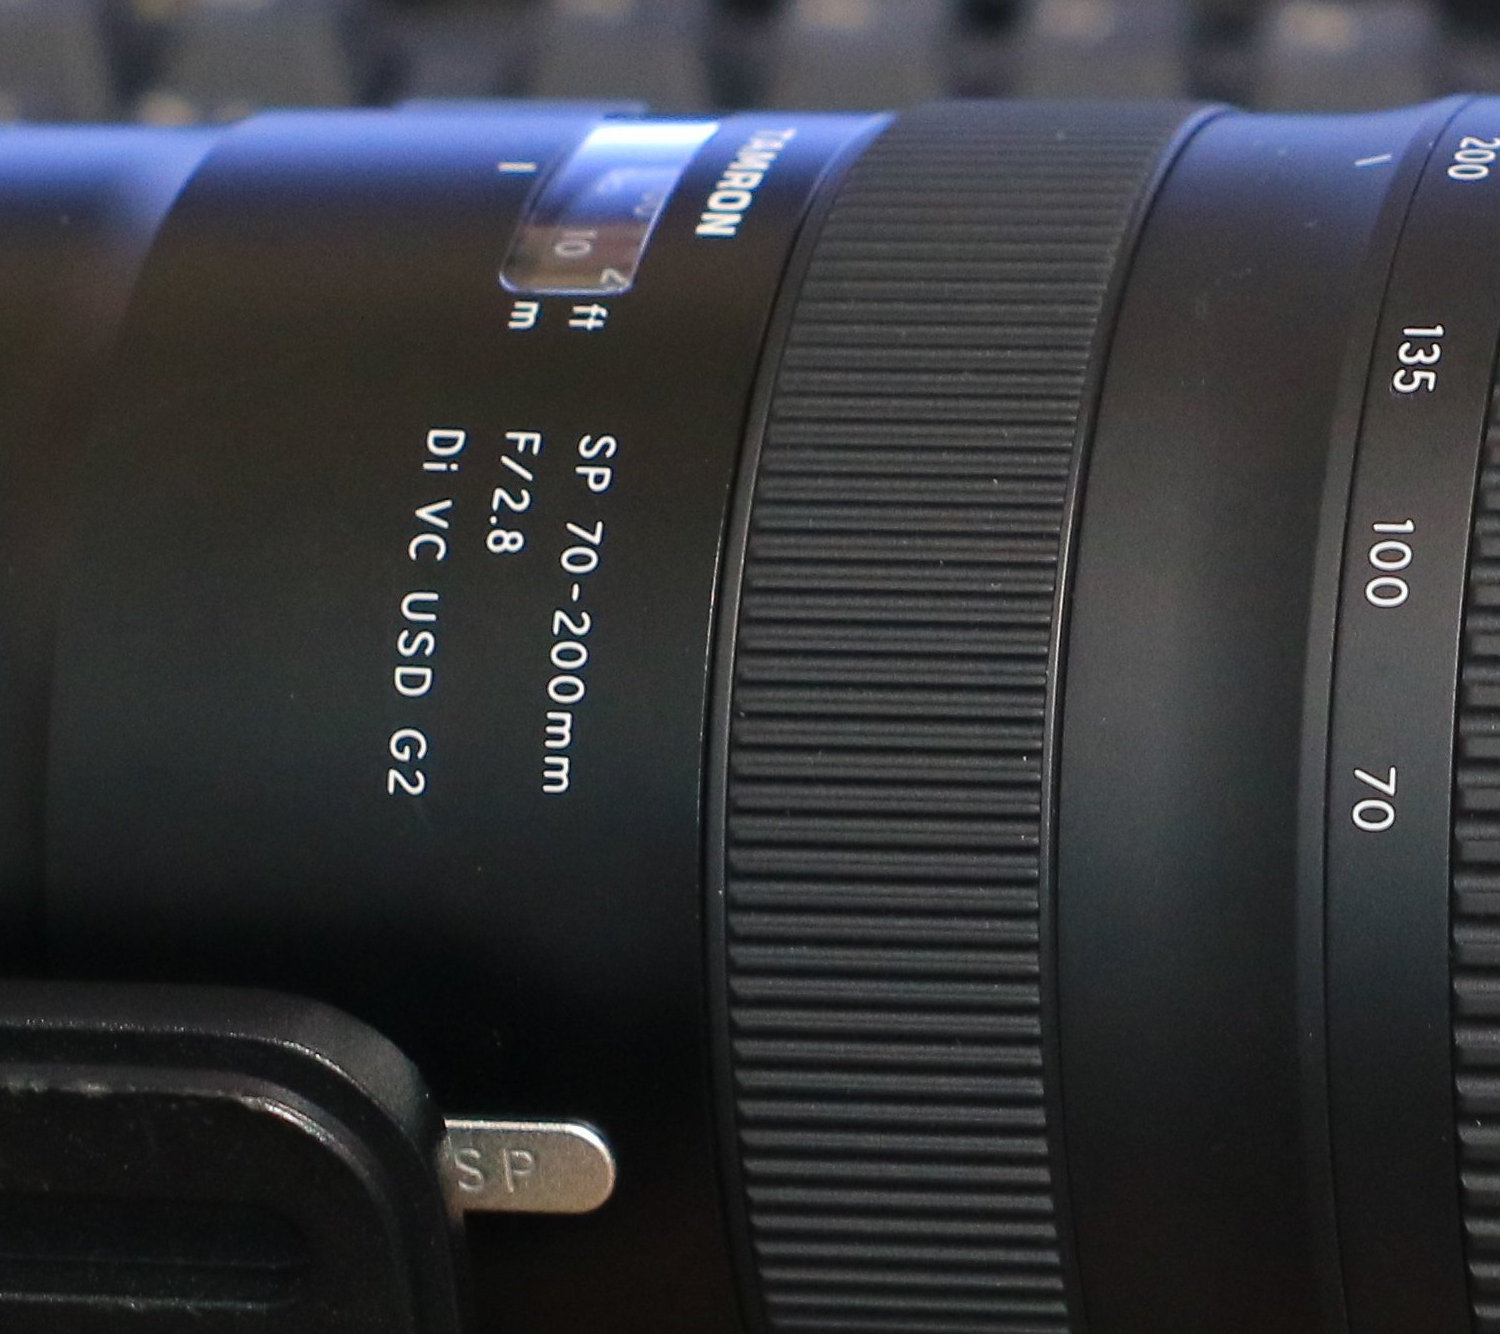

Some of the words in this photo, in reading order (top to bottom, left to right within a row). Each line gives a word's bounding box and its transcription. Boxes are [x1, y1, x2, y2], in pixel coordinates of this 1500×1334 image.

[694, 128, 797, 237] TAMRON
[508, 300, 539, 330] m
[568, 304, 608, 331] ft
[1391, 323, 1445, 395] 135
[422, 429, 466, 473] Di
[575, 434, 617, 493] SP
[486, 431, 542, 554] F/2.8
[408, 499, 453, 561] VC
[1364, 519, 1415, 609] 100
[393, 592, 439, 698] USD
[542, 520, 604, 793] 70-200mm
[387, 728, 428, 796] G2
[1351, 766, 1398, 833] 70
[454, 1147, 536, 1194] SP
